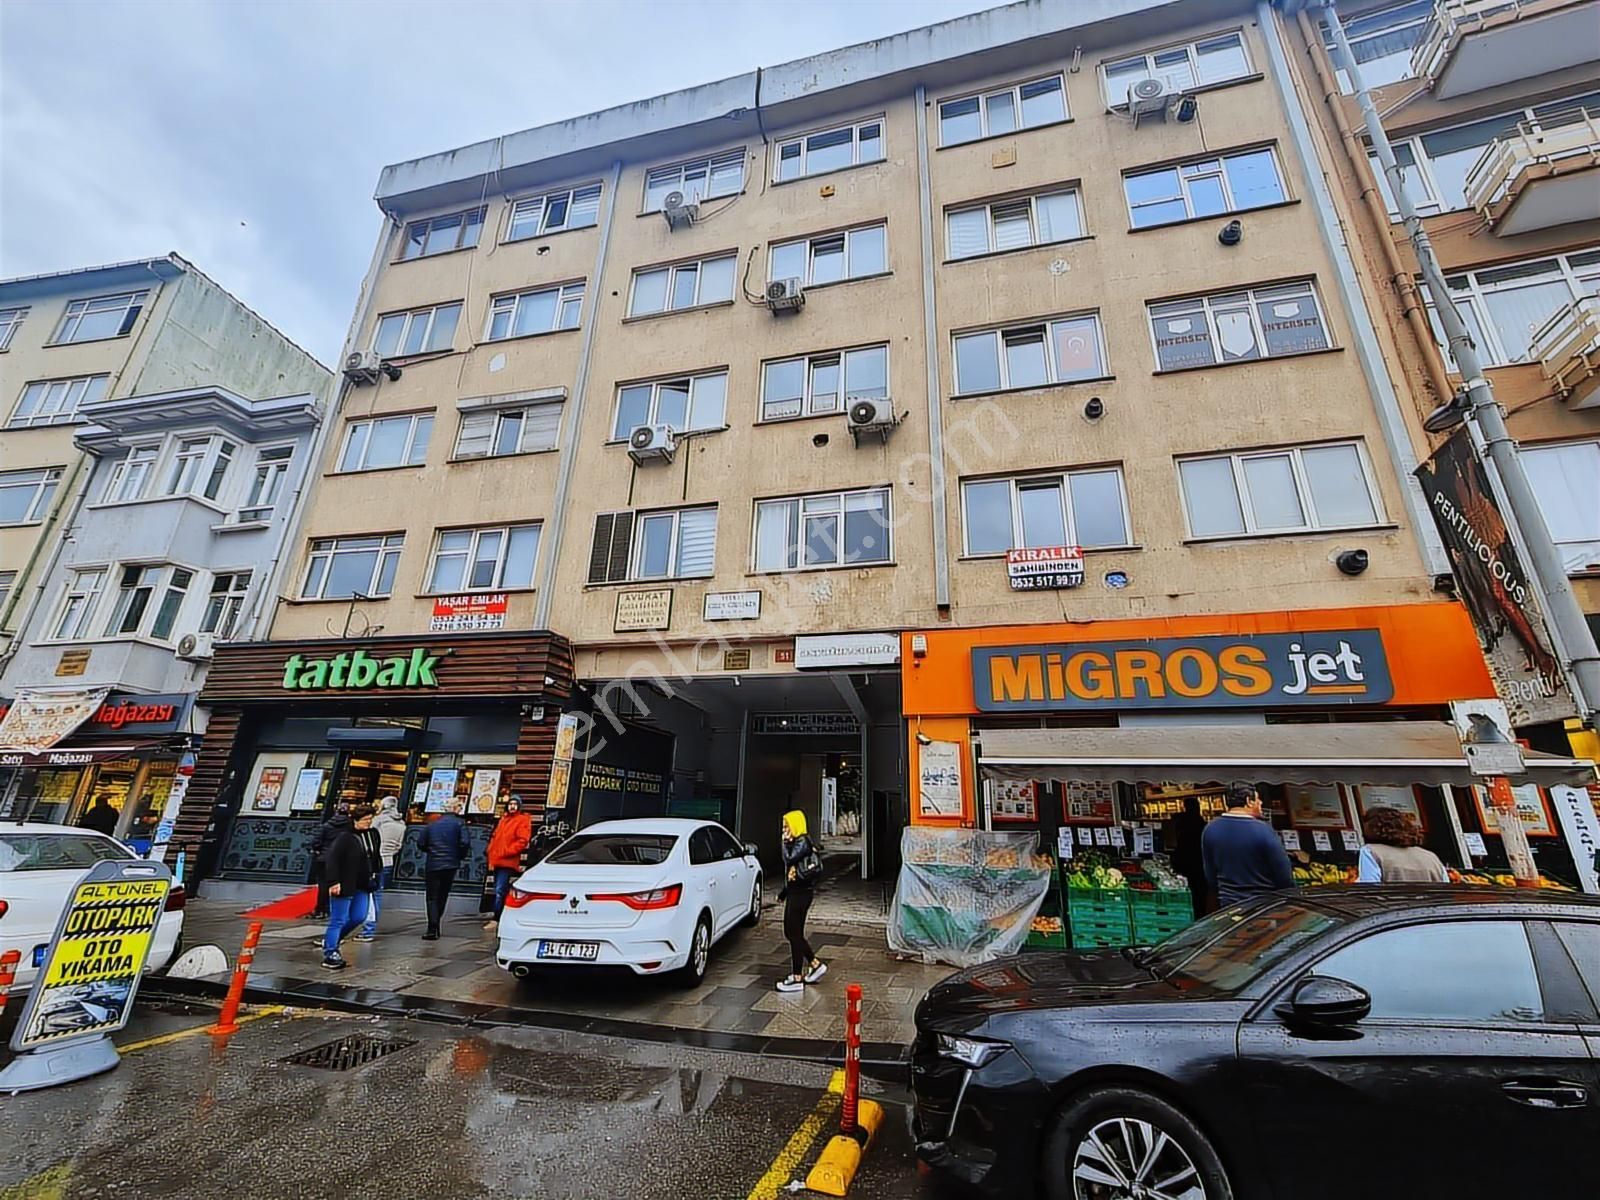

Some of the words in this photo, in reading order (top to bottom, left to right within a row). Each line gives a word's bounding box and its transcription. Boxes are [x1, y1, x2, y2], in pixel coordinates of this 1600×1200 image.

[1011, 576, 1034, 588] 0532
[1036, 575, 1053, 587] 517
[1056, 574, 1068, 585] 99
[1070, 573, 1082, 584] 77
[283, 648, 440, 689] tatbak
[1283, 640, 1365, 695] jet
[49, 752, 93, 766] Mağazası
[81, 883, 163, 897] ALTUNEL
[66, 906, 157, 932] OTOPARK
[83, 938, 122, 958] OTO
[579, 944, 595, 957] 123
[60, 955, 133, 978] YIKAMA
